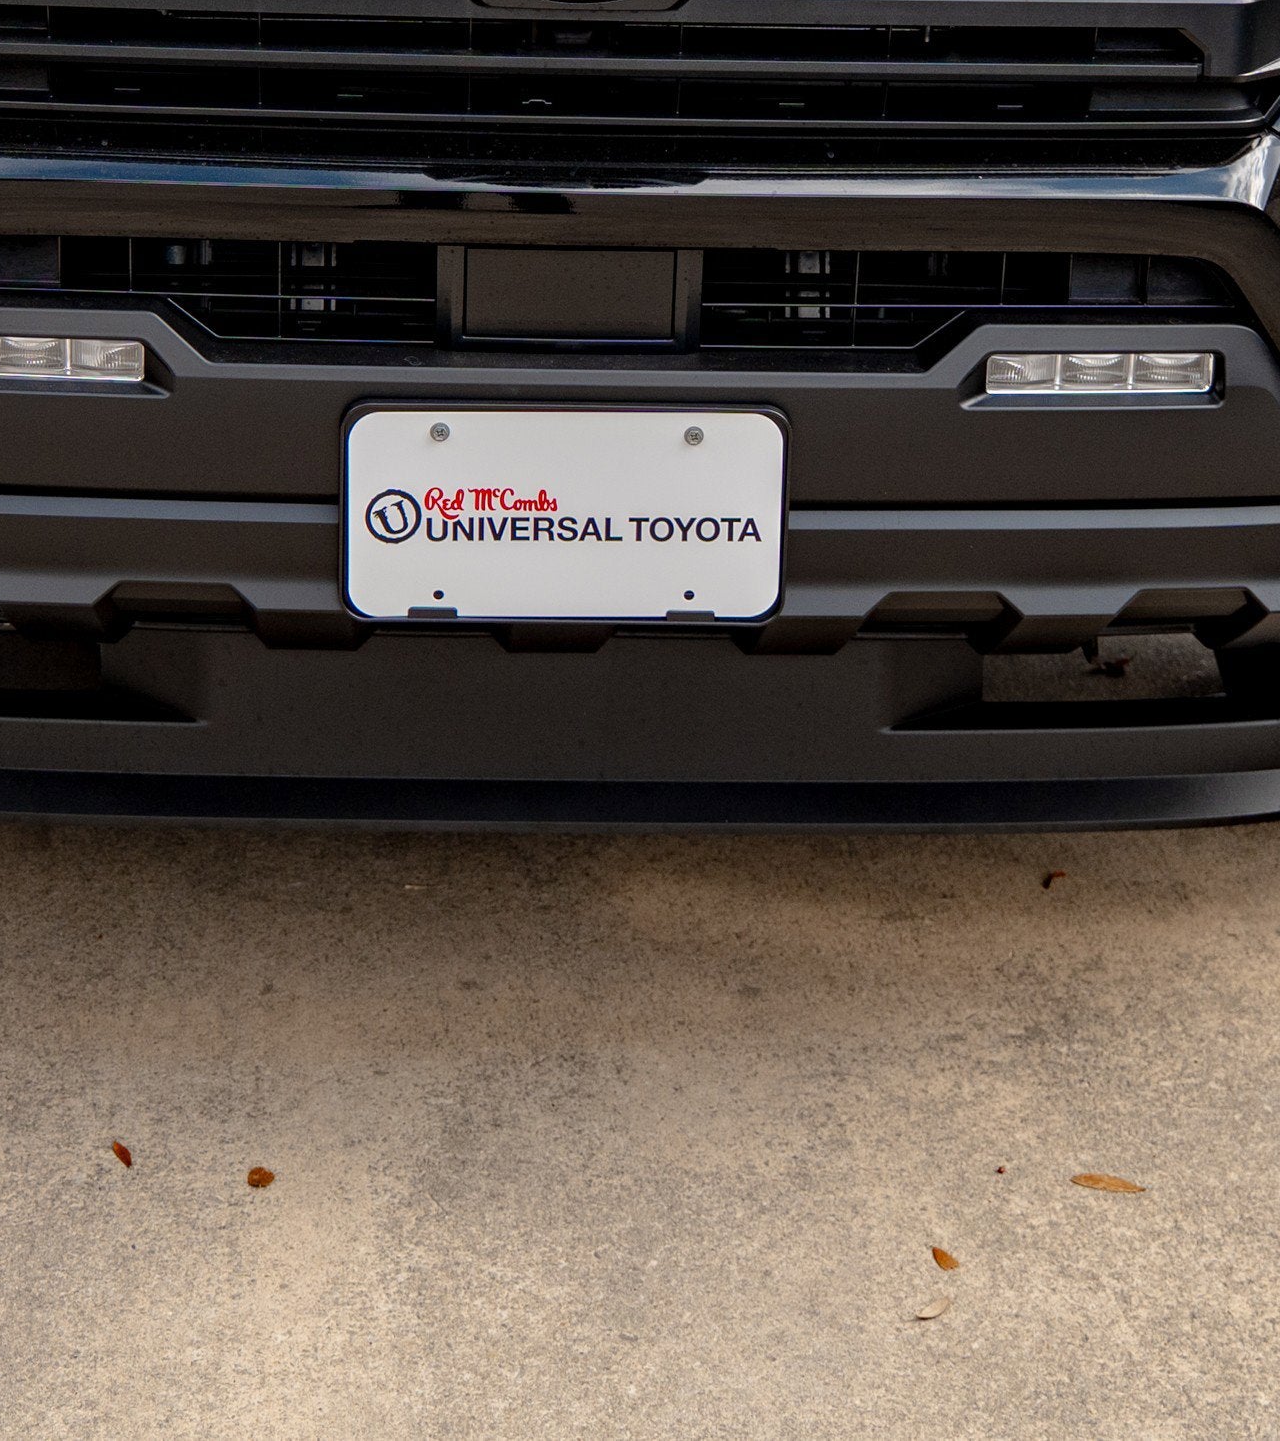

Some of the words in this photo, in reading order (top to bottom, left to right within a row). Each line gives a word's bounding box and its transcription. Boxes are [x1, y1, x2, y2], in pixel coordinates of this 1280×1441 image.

[424, 487, 465, 520] Red
[426, 516, 623, 543] UNIVERSAL
[628, 516, 763, 543] TOYOTA
